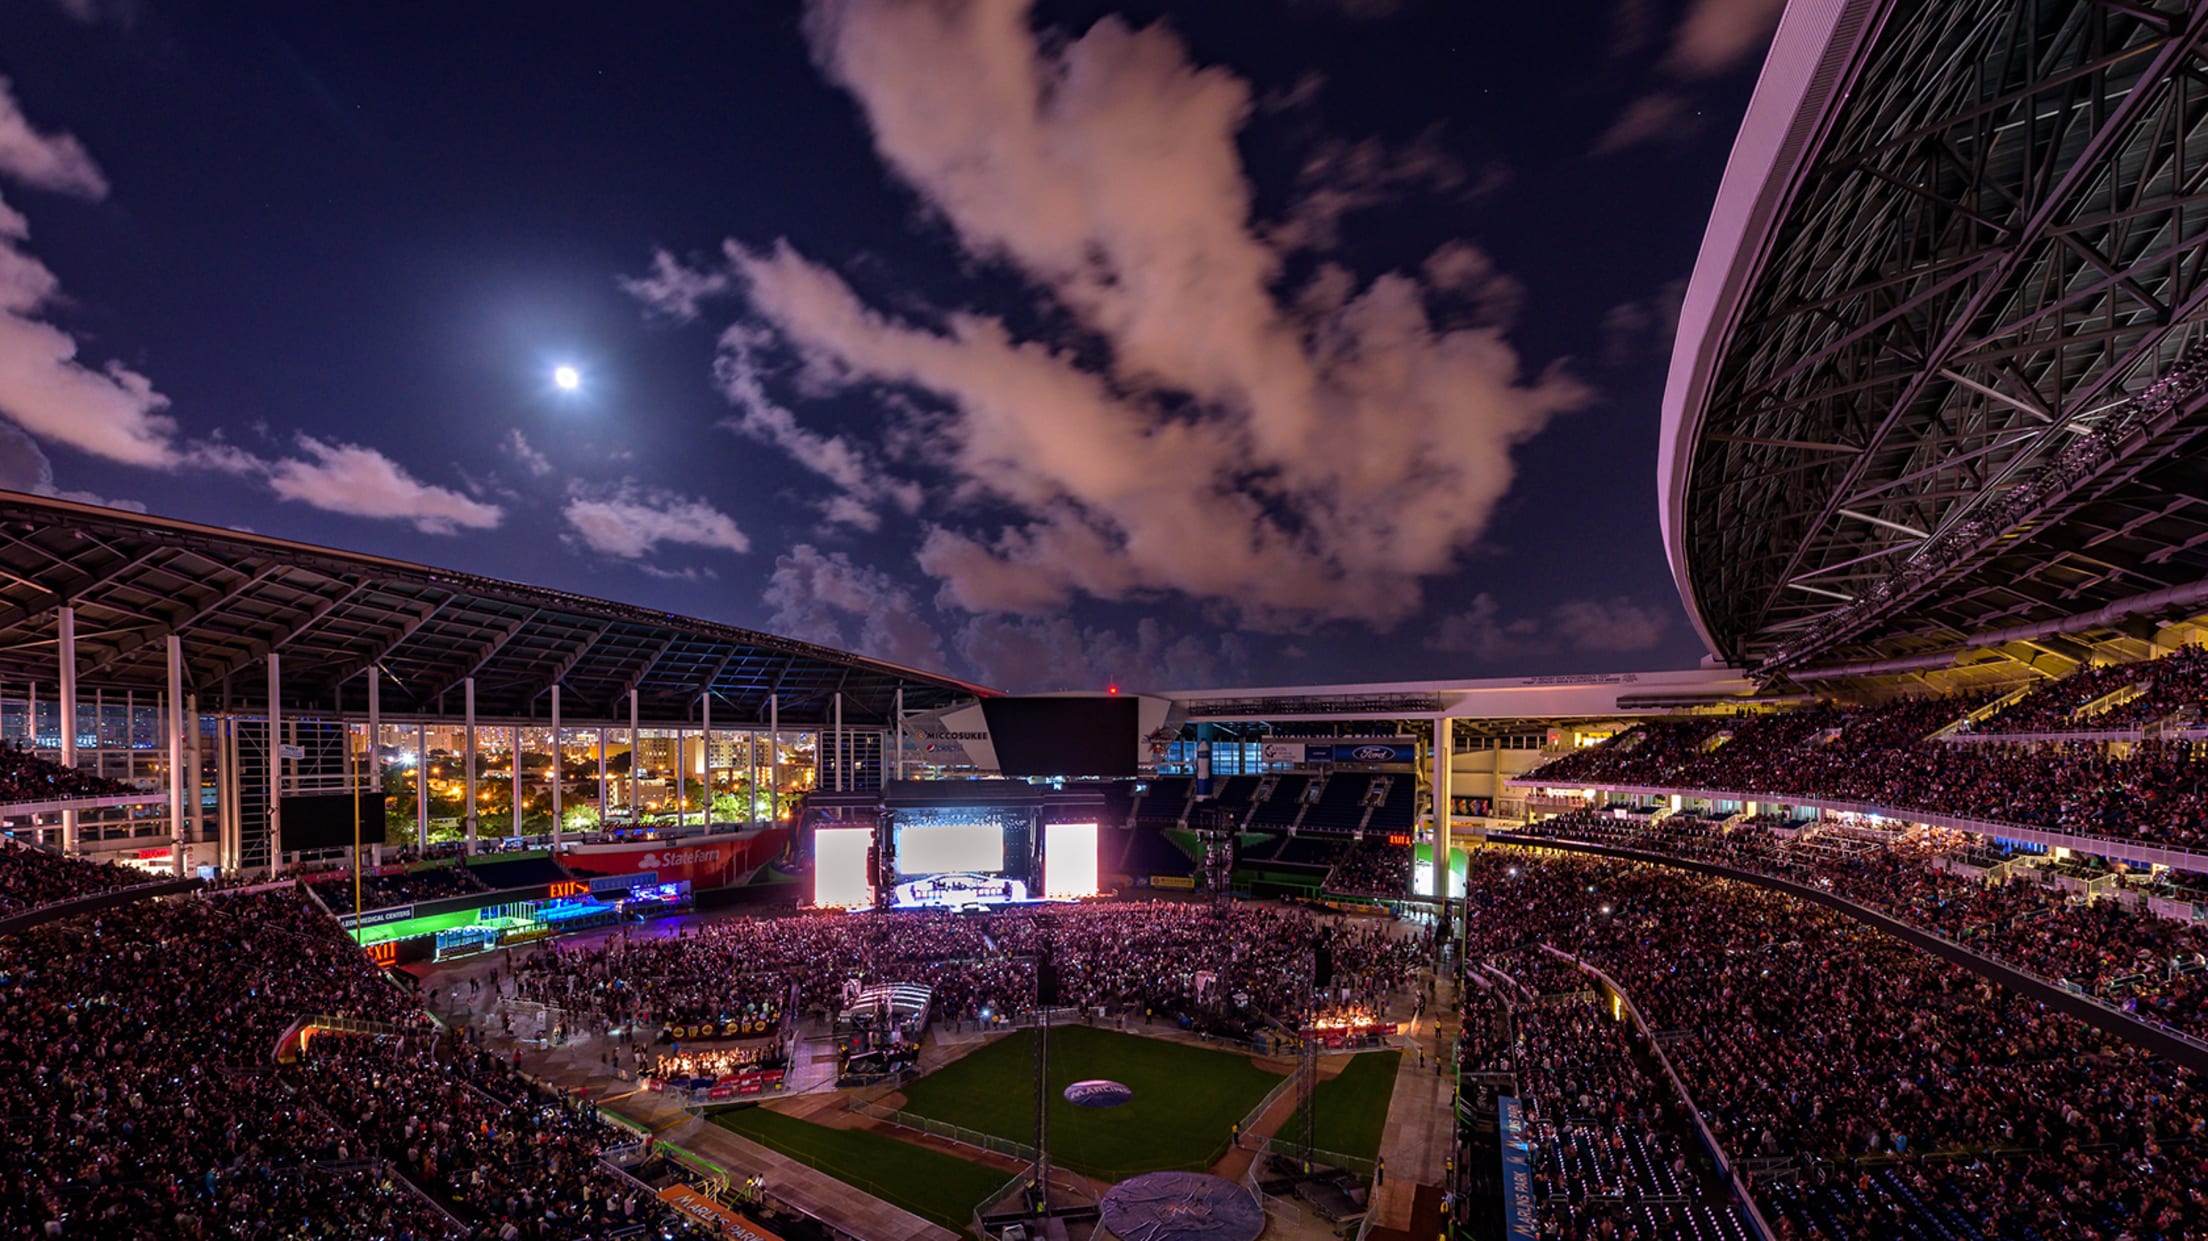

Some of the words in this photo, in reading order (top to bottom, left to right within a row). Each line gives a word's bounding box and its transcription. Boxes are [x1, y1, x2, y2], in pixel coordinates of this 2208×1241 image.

[927, 731, 988, 740] MICCOSUKEE
[1360, 748, 1387, 760] Ford
[551, 881, 577, 898] EXIT
[385, 909, 411, 921] CENTERS
[1512, 1170, 1529, 1193] PARK
